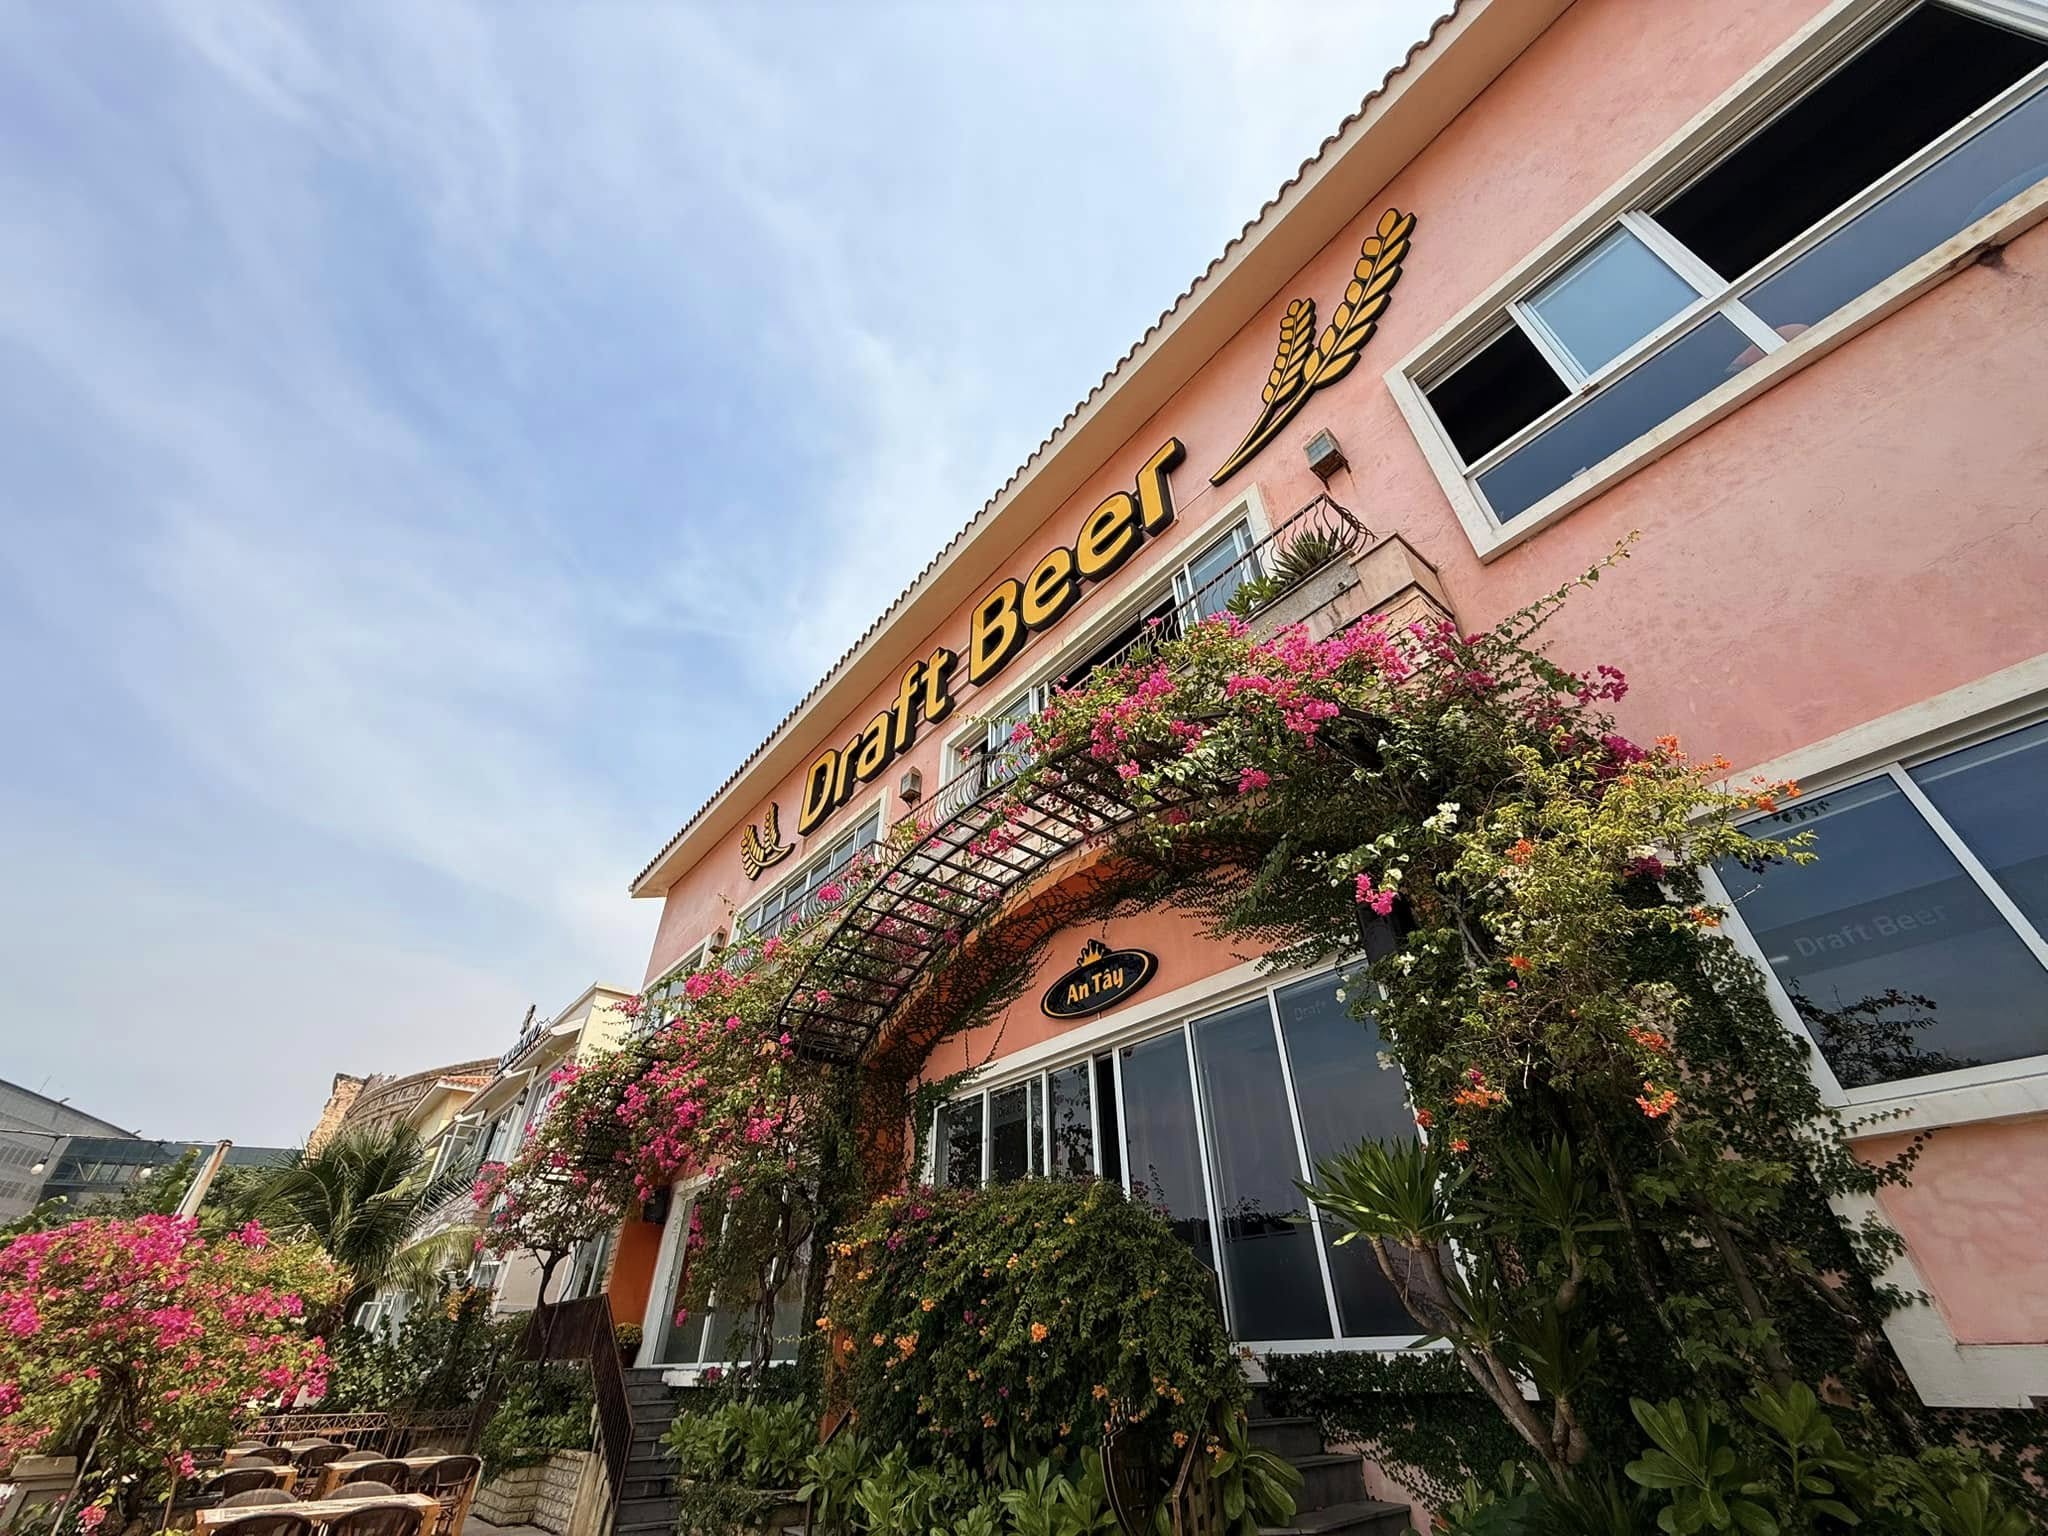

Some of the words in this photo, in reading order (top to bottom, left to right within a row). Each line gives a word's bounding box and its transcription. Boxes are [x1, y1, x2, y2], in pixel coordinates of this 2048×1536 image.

[798, 648, 957, 836] Draft
[968, 437, 1185, 687] Beer
[1793, 922, 1872, 957] Draft
[1873, 905, 1947, 936] Beer
[1067, 984, 1089, 1005] An
[1091, 967, 1125, 993] Tây
